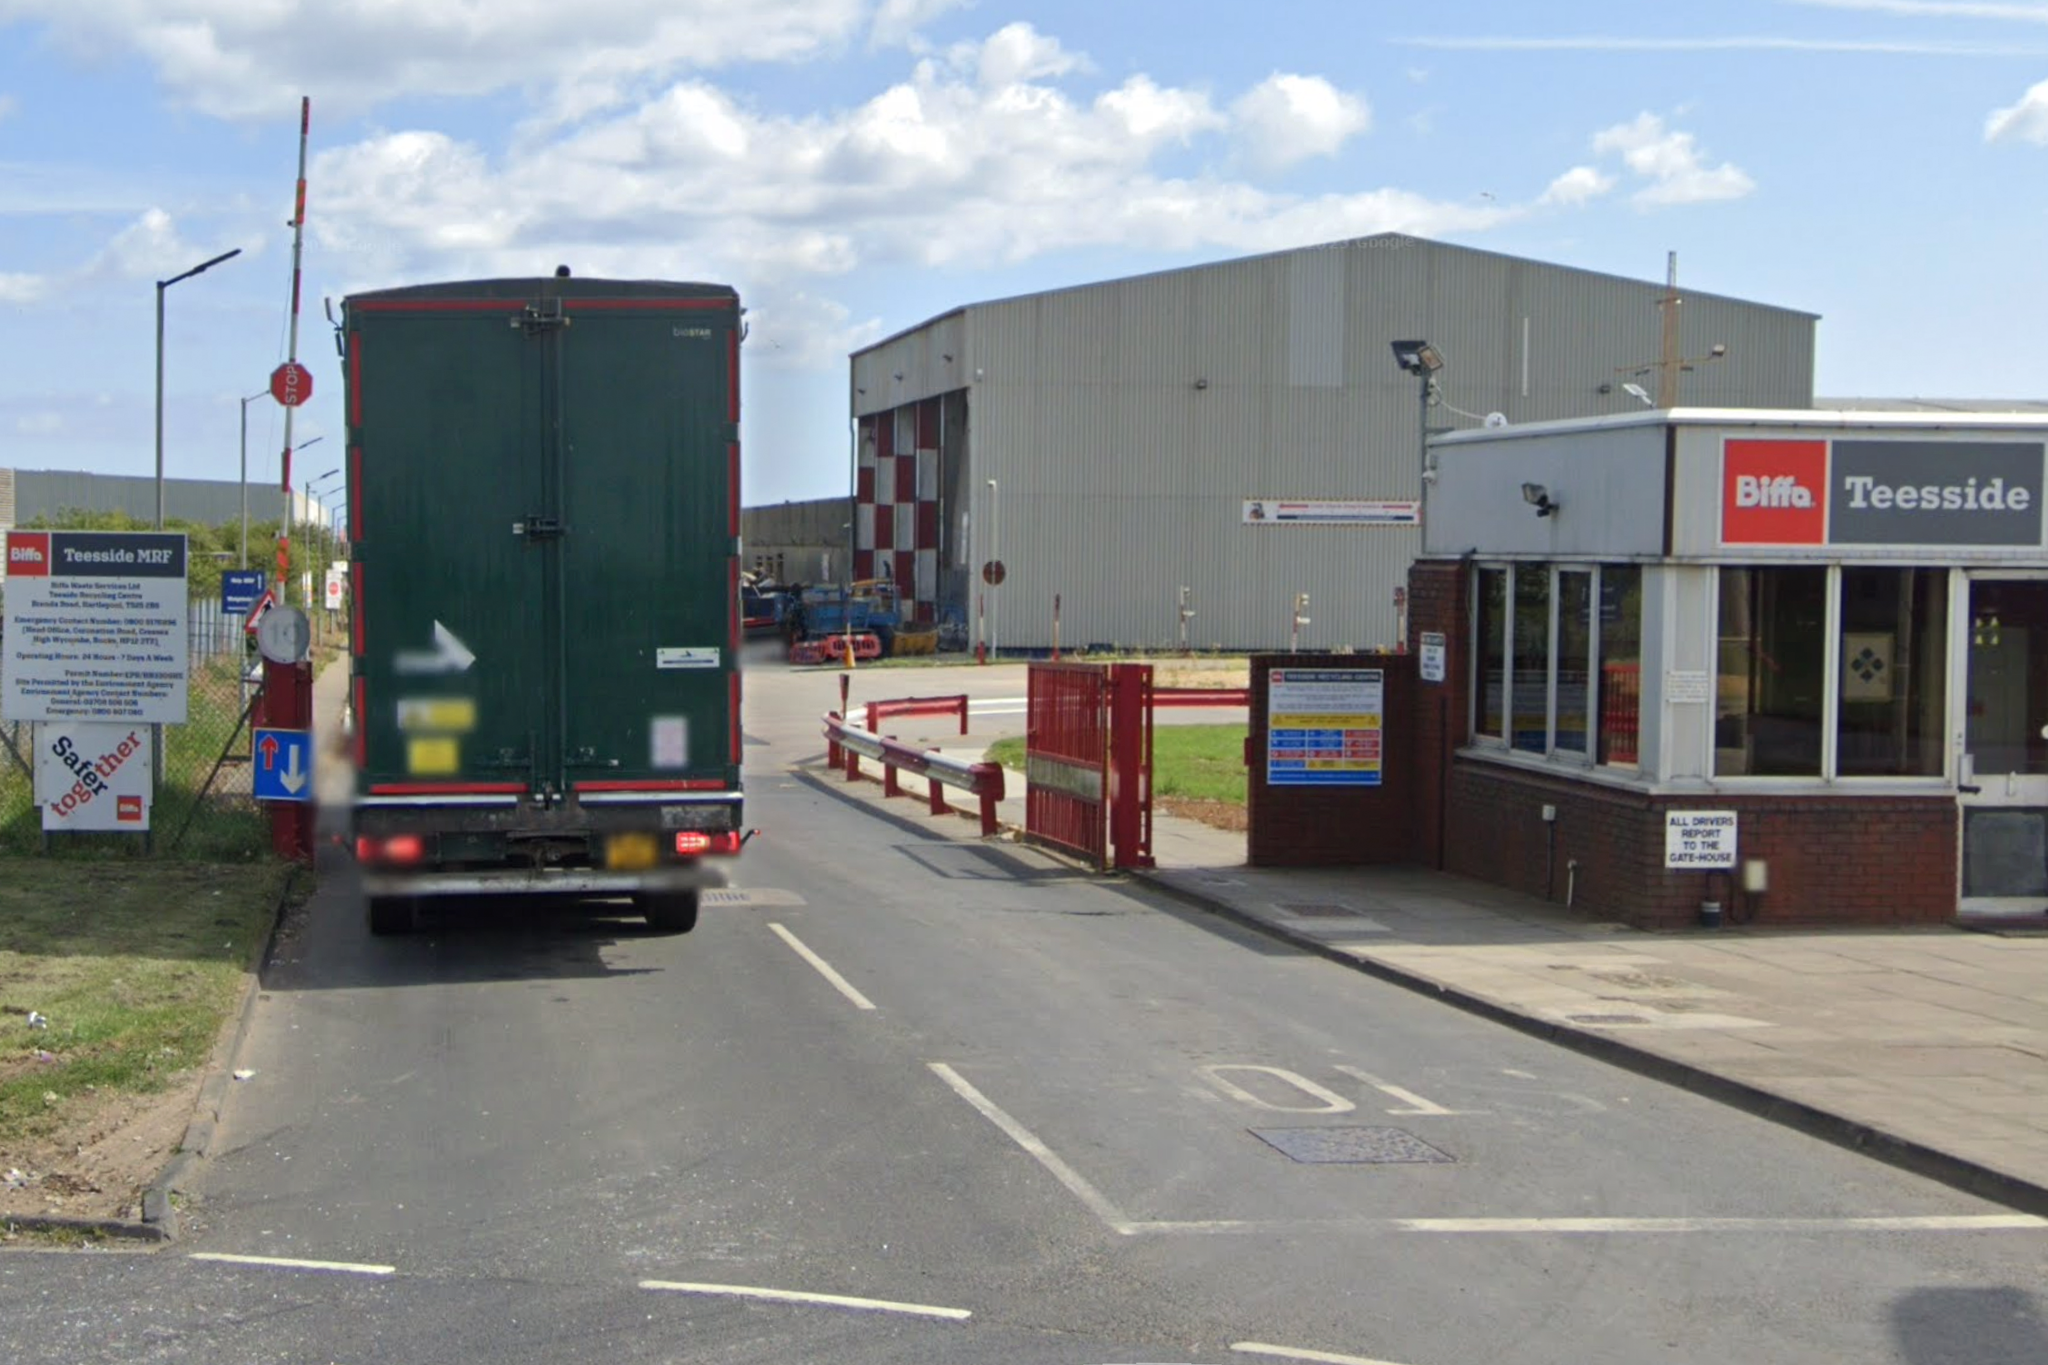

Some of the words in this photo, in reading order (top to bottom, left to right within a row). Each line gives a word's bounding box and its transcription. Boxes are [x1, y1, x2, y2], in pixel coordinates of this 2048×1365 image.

[285, 363, 298, 404] STOP
[1735, 474, 1815, 509] Biffa
[1845, 475, 2030, 511] Teesside
[10, 546, 43, 562] Biffa
[64, 548, 134, 563] Teesside
[136, 549, 173, 564] MRF
[15, 617, 56, 625] Emergency
[16, 651, 53, 660] Operating
[153, 654, 174, 662] Week
[51, 735, 109, 797] Safer
[1669, 816, 1688, 826] ALL
[1692, 816, 1734, 826] DRIVERS
[1681, 828, 1721, 838] REPORT
[1683, 841, 1697, 850] TO
[1701, 841, 1720, 850] THE
[1669, 853, 1732, 863] GATE-HOUSE
